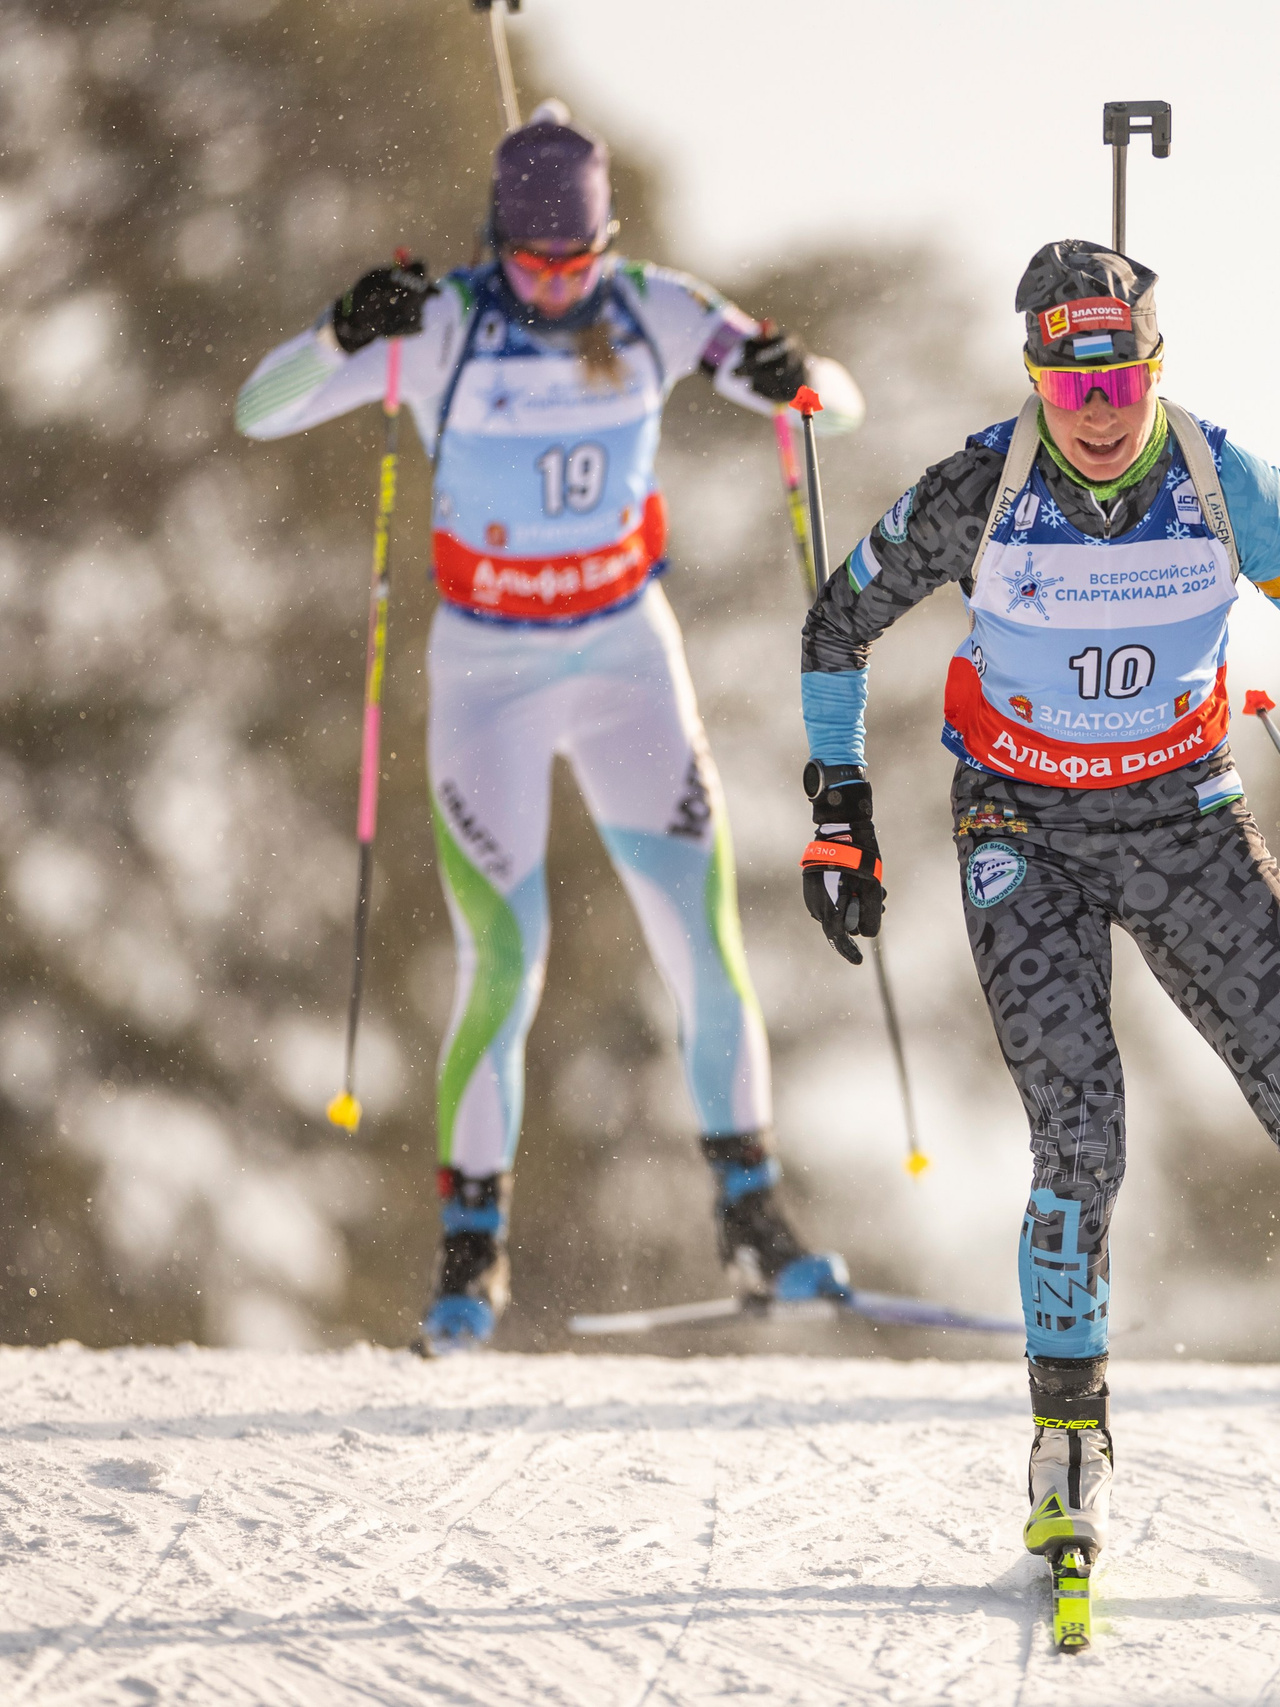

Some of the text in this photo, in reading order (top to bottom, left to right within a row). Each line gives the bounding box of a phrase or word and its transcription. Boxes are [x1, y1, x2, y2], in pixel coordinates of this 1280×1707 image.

[1071, 307, 1123, 318] ЗЛАТОУСТ
[537, 442, 607, 517] 19
[1205, 492, 1231, 545] LARSEN
[1089, 560, 1215, 586] ВСЕРОССИЙСКАЯ
[1054, 574, 1217, 602] СПАРТАКИАДА 2024
[1069, 644, 1156, 700] 10
[1039, 702, 1169, 731] ЗЛАТОУСТ
[991, 730, 1113, 784] Альфа
[1033, 1414, 1099, 1429] SCHER
